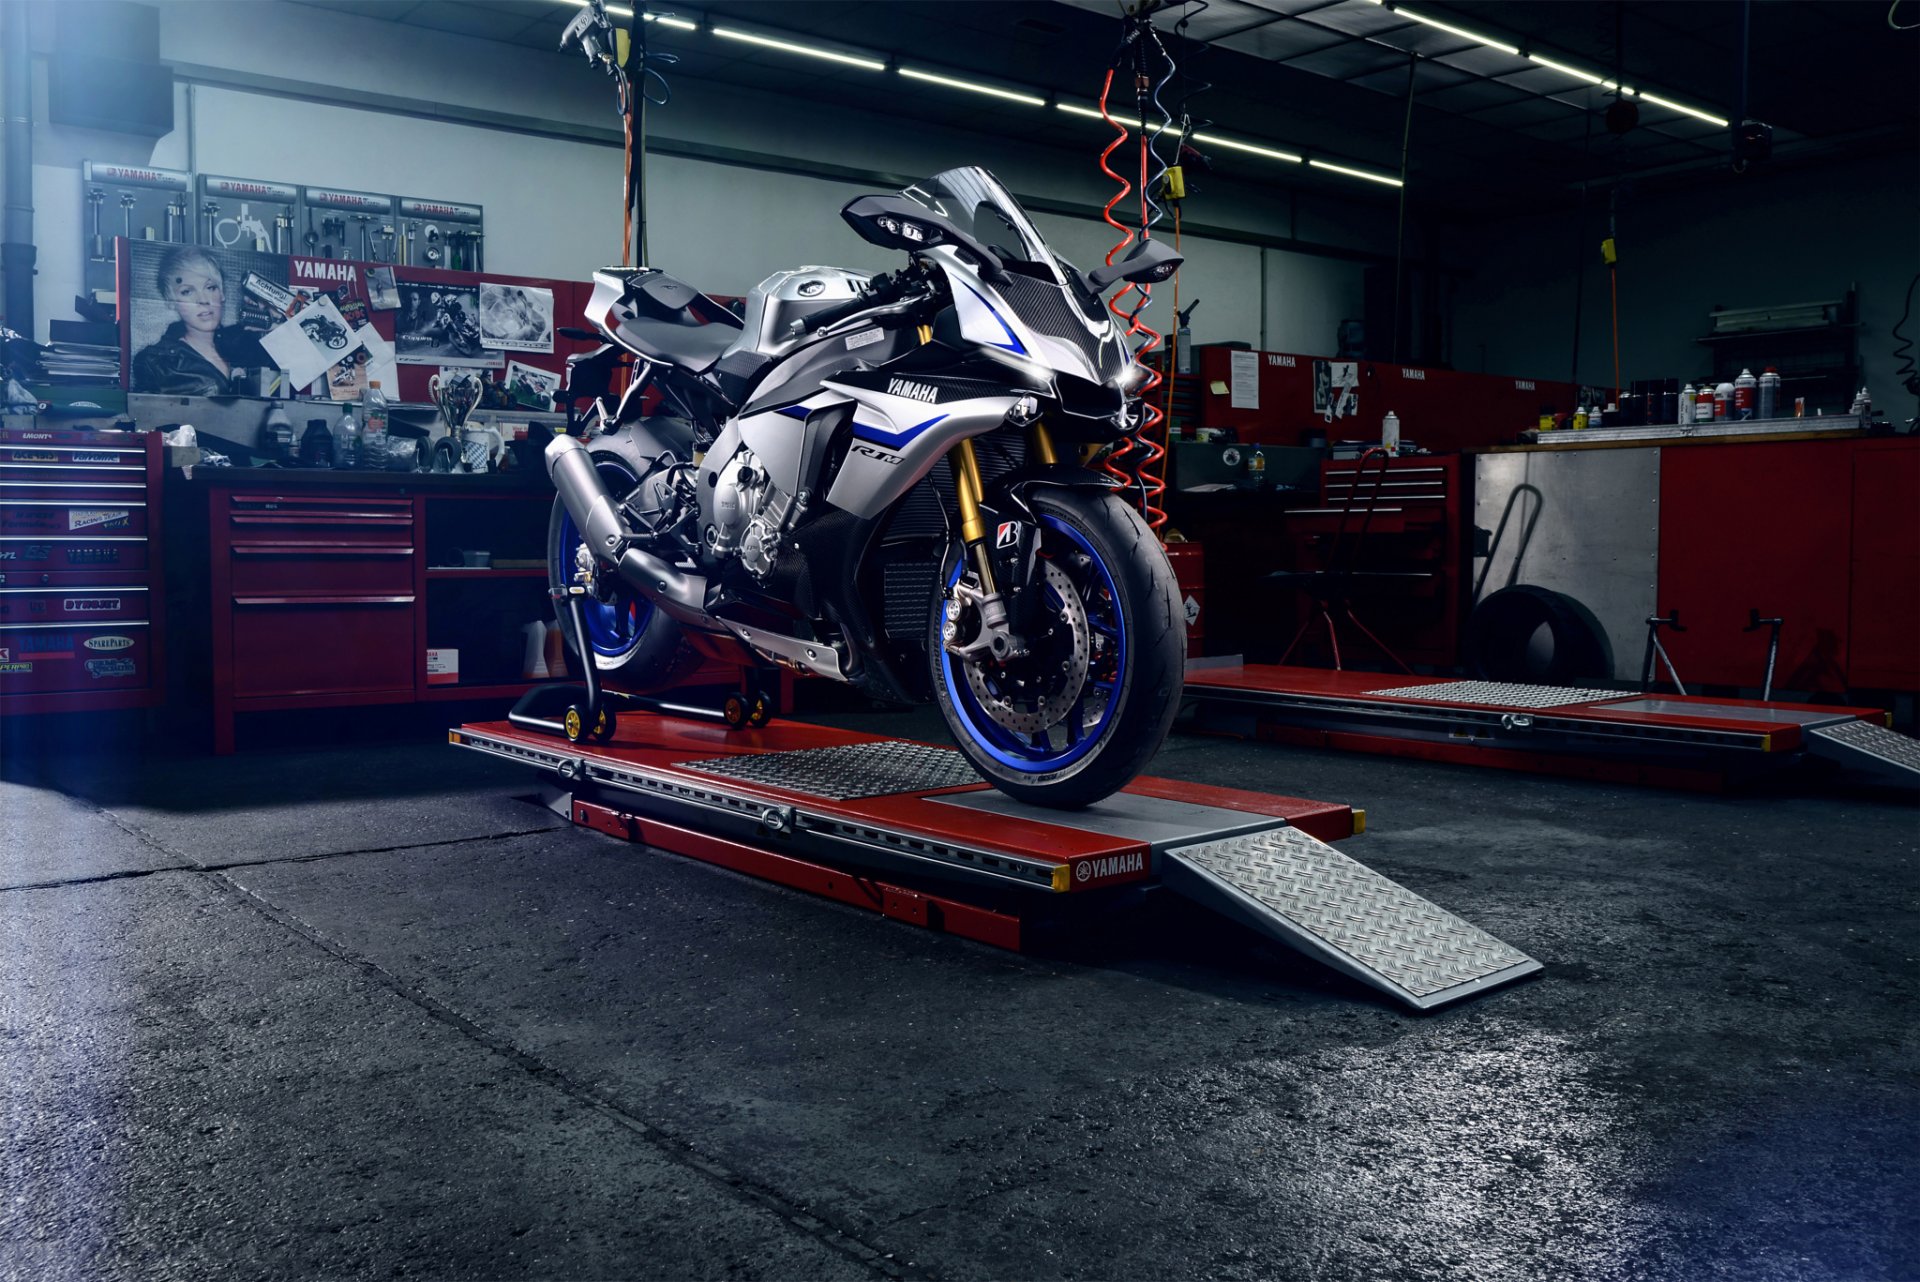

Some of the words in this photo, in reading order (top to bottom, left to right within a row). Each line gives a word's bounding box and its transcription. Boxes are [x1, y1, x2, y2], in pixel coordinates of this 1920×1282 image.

[118, 168, 157, 181] YAMAHA
[230, 182, 267, 194] YAMAHA
[328, 193, 363, 205] YAMAHA
[422, 204, 455, 216] YAMAHA
[294, 260, 357, 281] YAMAHA
[1267, 354, 1296, 368] YAMAHA
[1402, 368, 1425, 380] YAMAHA
[886, 377, 939, 404] YAMAHA
[1515, 380, 1535, 391] YAMAHA
[851, 445, 905, 465] R1M
[65, 600, 120, 610] DYNOJET
[1092, 852, 1143, 878] YAMAHA
